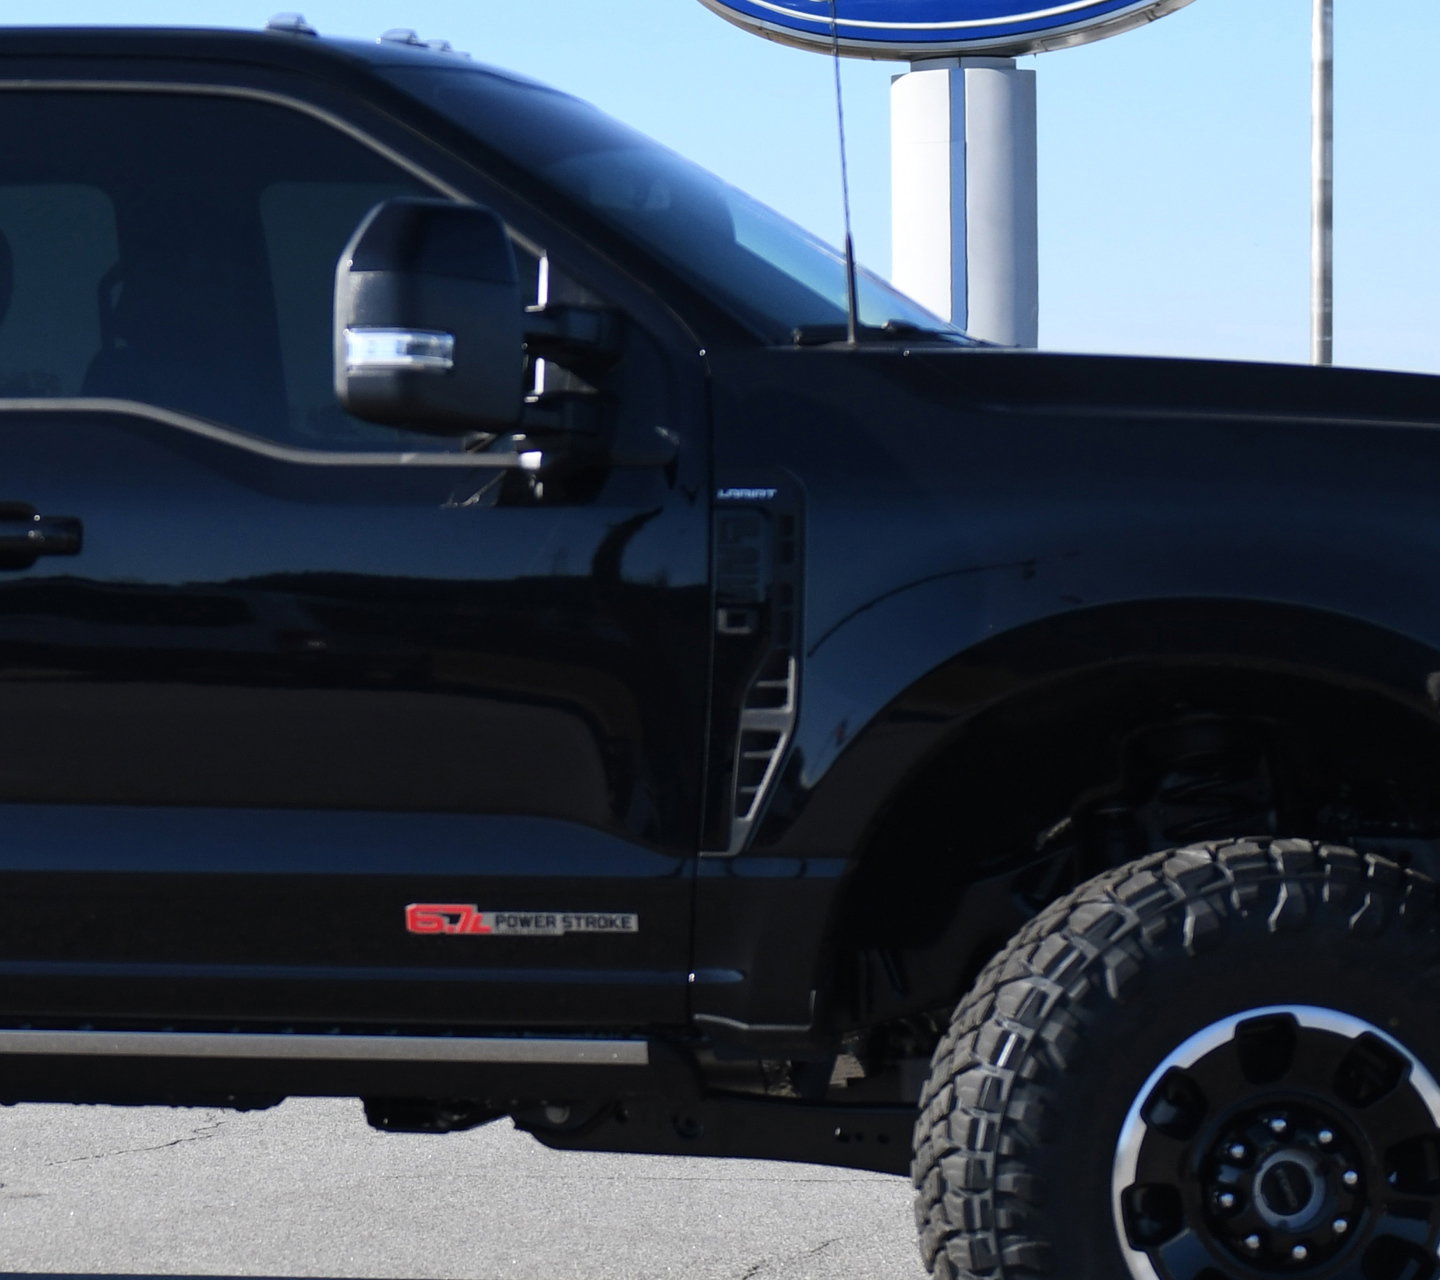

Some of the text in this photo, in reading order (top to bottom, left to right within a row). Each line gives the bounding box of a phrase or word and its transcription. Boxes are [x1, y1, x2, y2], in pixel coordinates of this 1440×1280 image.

[406, 904, 633, 934] 6.7L POWER STROKE
